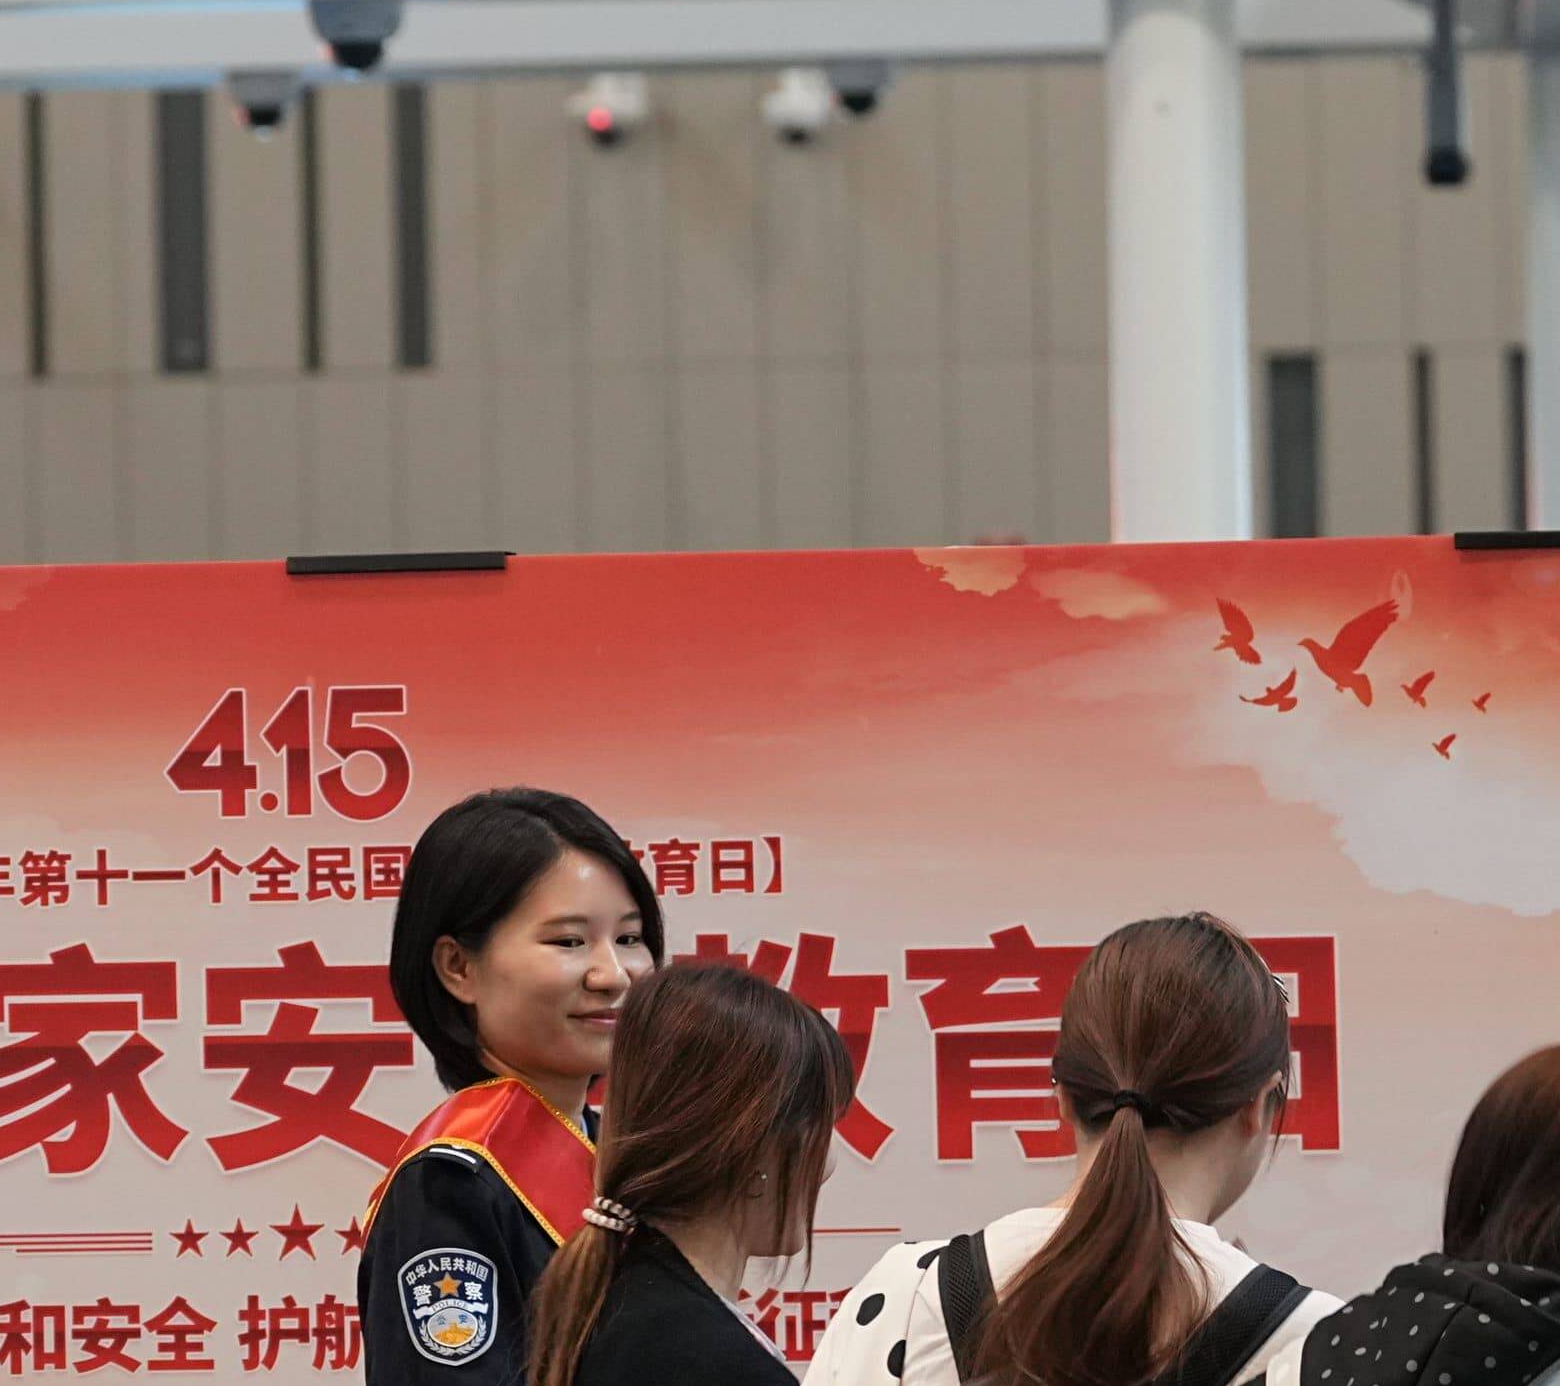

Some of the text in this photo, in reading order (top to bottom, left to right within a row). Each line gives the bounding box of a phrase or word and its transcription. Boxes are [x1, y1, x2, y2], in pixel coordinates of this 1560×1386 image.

[164, 684, 412, 822] 4.15
[405, 1257, 489, 1286] 中华人民共和国
[412, 1281, 484, 1306] 警察
